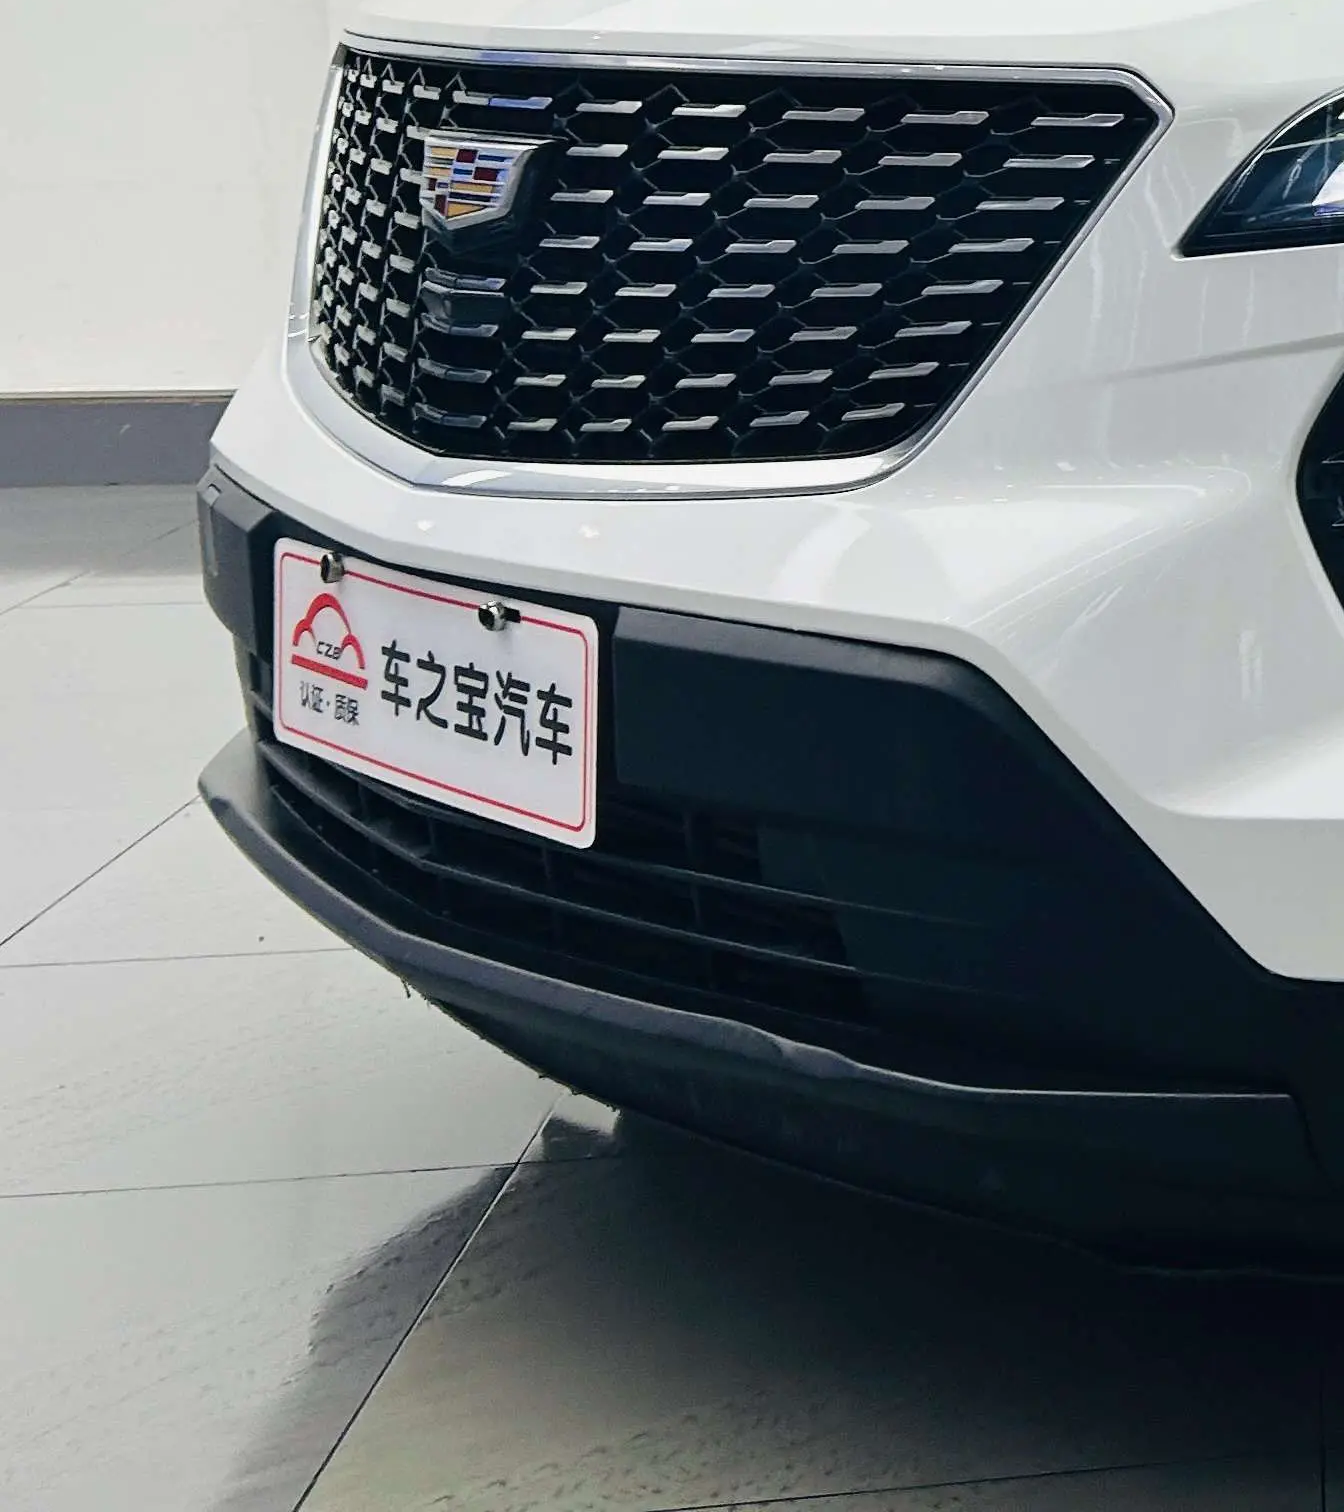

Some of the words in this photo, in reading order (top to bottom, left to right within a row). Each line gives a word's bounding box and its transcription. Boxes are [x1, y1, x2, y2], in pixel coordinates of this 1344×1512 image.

[315, 640, 342, 661] CZB
[381, 639, 574, 766] 车之宝汽车
